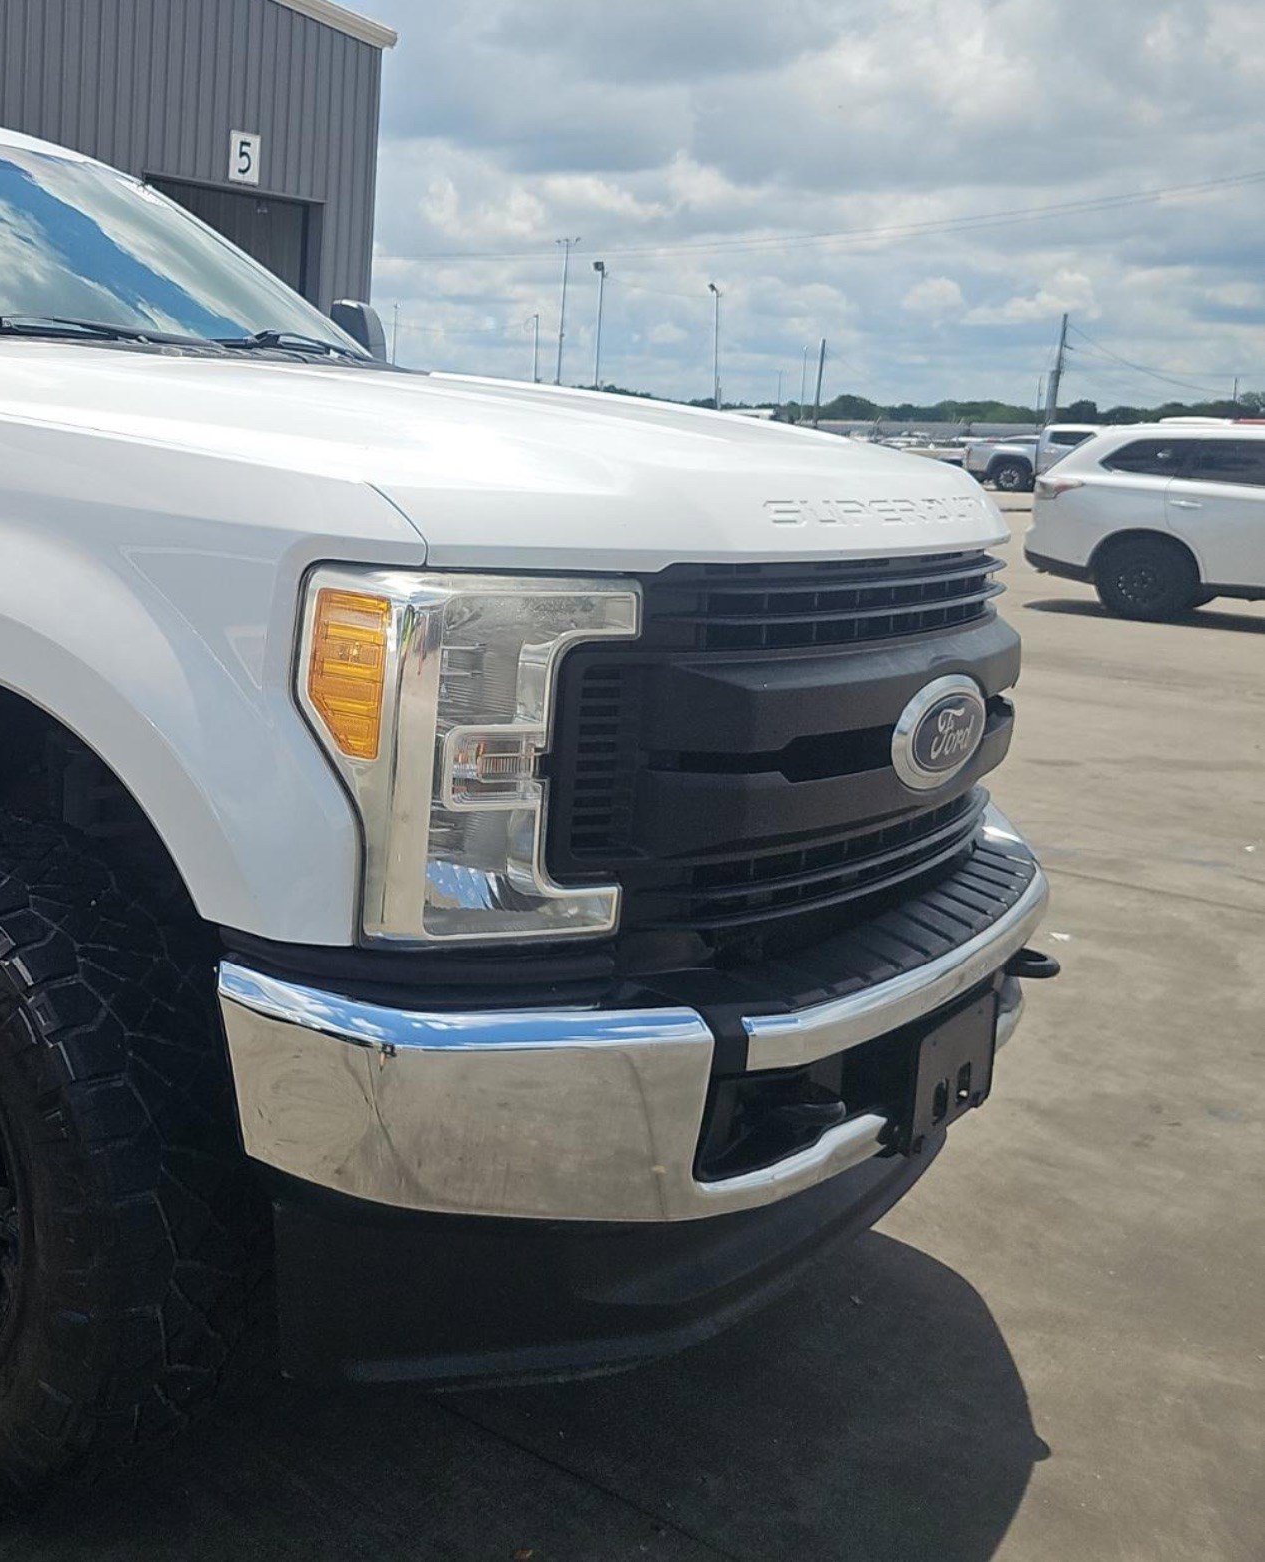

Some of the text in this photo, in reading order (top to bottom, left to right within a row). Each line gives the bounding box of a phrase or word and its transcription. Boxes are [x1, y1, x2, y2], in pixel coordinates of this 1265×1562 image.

[238, 141, 251, 174] 5
[762, 498, 925, 528] SUPER
[930, 707, 975, 760] Ford
